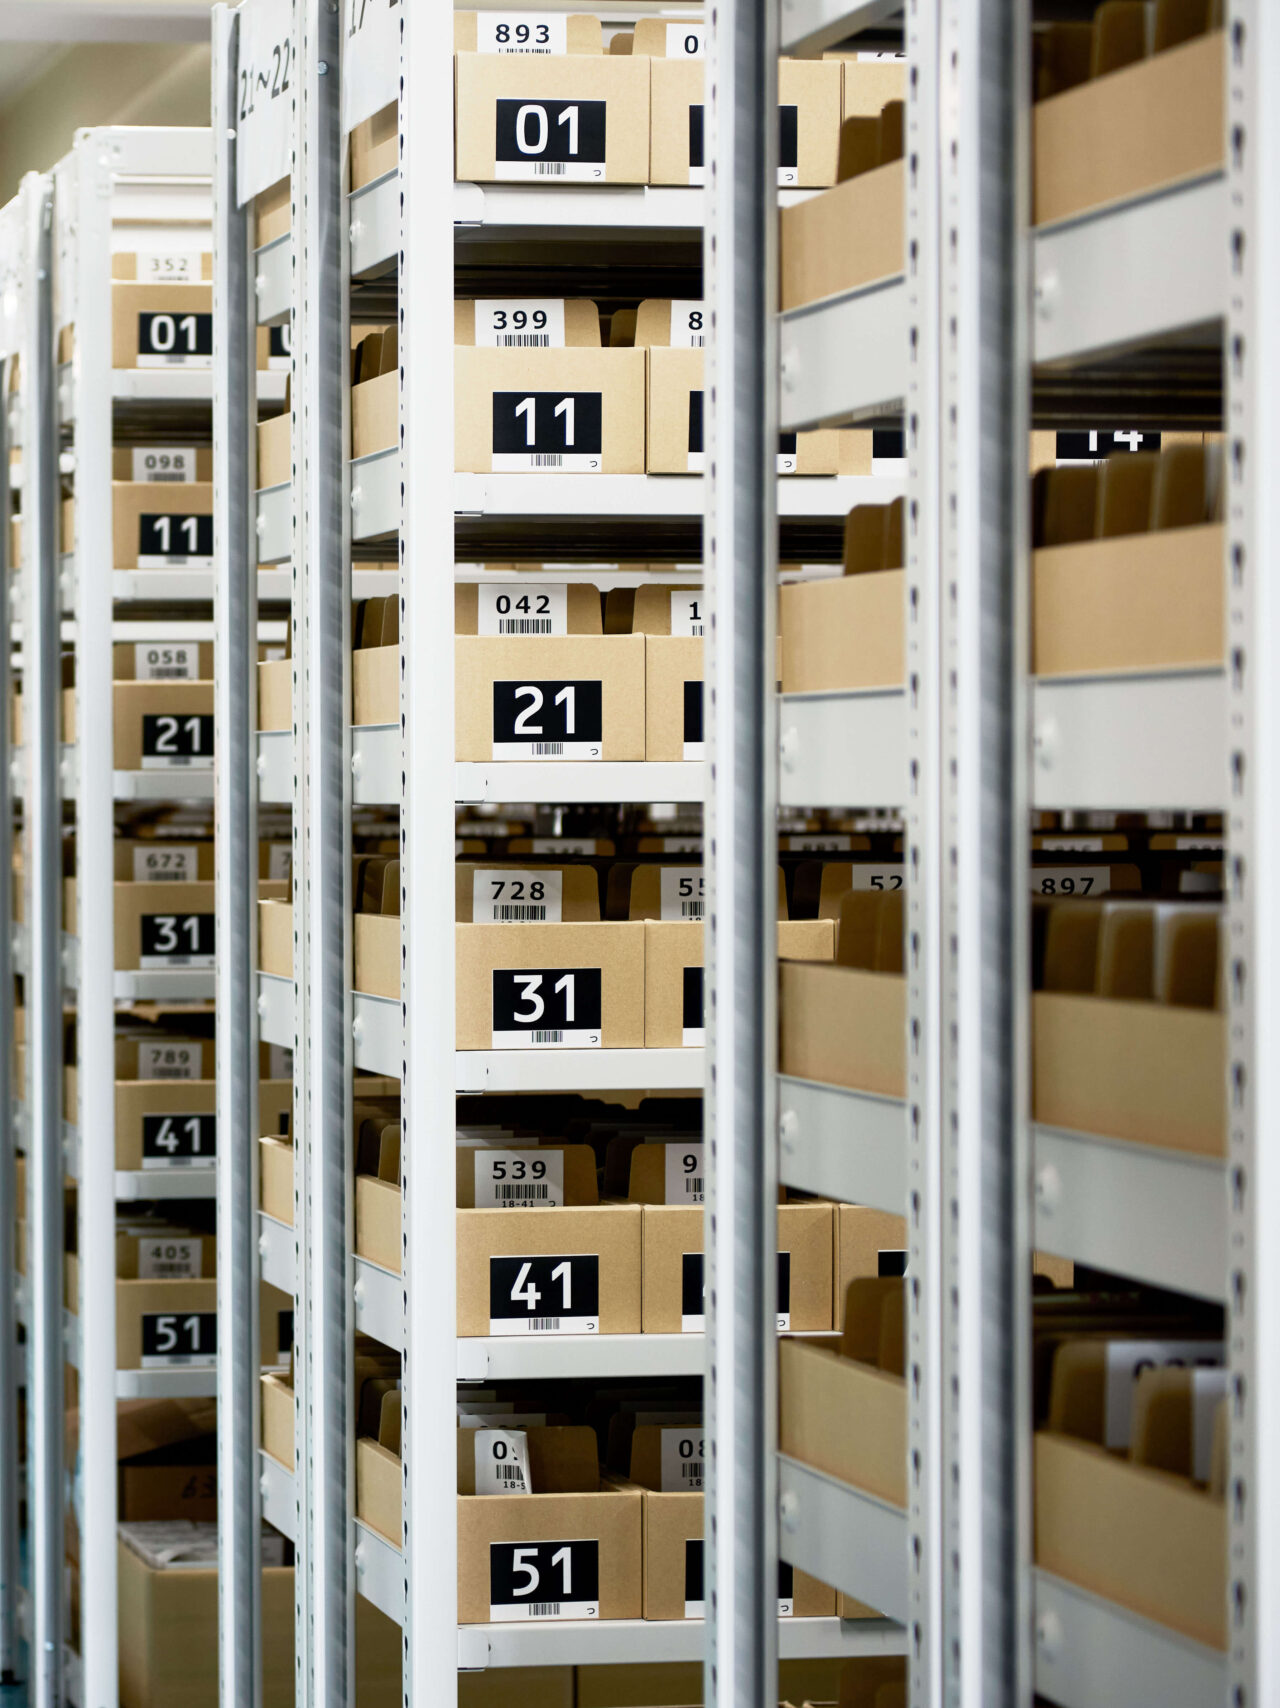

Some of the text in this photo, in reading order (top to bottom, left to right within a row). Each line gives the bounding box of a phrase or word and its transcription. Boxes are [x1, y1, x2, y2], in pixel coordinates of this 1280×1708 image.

[496, 24, 550, 43] 893
[516, 104, 579, 155] 01
[151, 258, 188, 272] 352
[493, 310, 548, 330] 399
[150, 315, 197, 352] 01
[515, 397, 575, 446] 11
[144, 454, 185, 470] 098
[153, 516, 198, 552] 11
[495, 595, 551, 614] 042
[147, 649, 187, 665] 058
[514, 685, 576, 735] 21
[155, 716, 201, 753] 21
[146, 853, 186, 869] 672
[491, 881, 545, 900] 728
[1041, 877, 1095, 895] 897
[153, 916, 199, 951] 31
[513, 974, 575, 1023] 31
[152, 1050, 190, 1065] 789
[155, 1117, 201, 1153] 41
[492, 1160, 547, 1180] 539
[502, 1200, 535, 1208] 18-41
[151, 1245, 191, 1261] 405
[510, 1261, 572, 1310] 41
[155, 1316, 200, 1352] 51
[512, 1546, 572, 1597] 51
